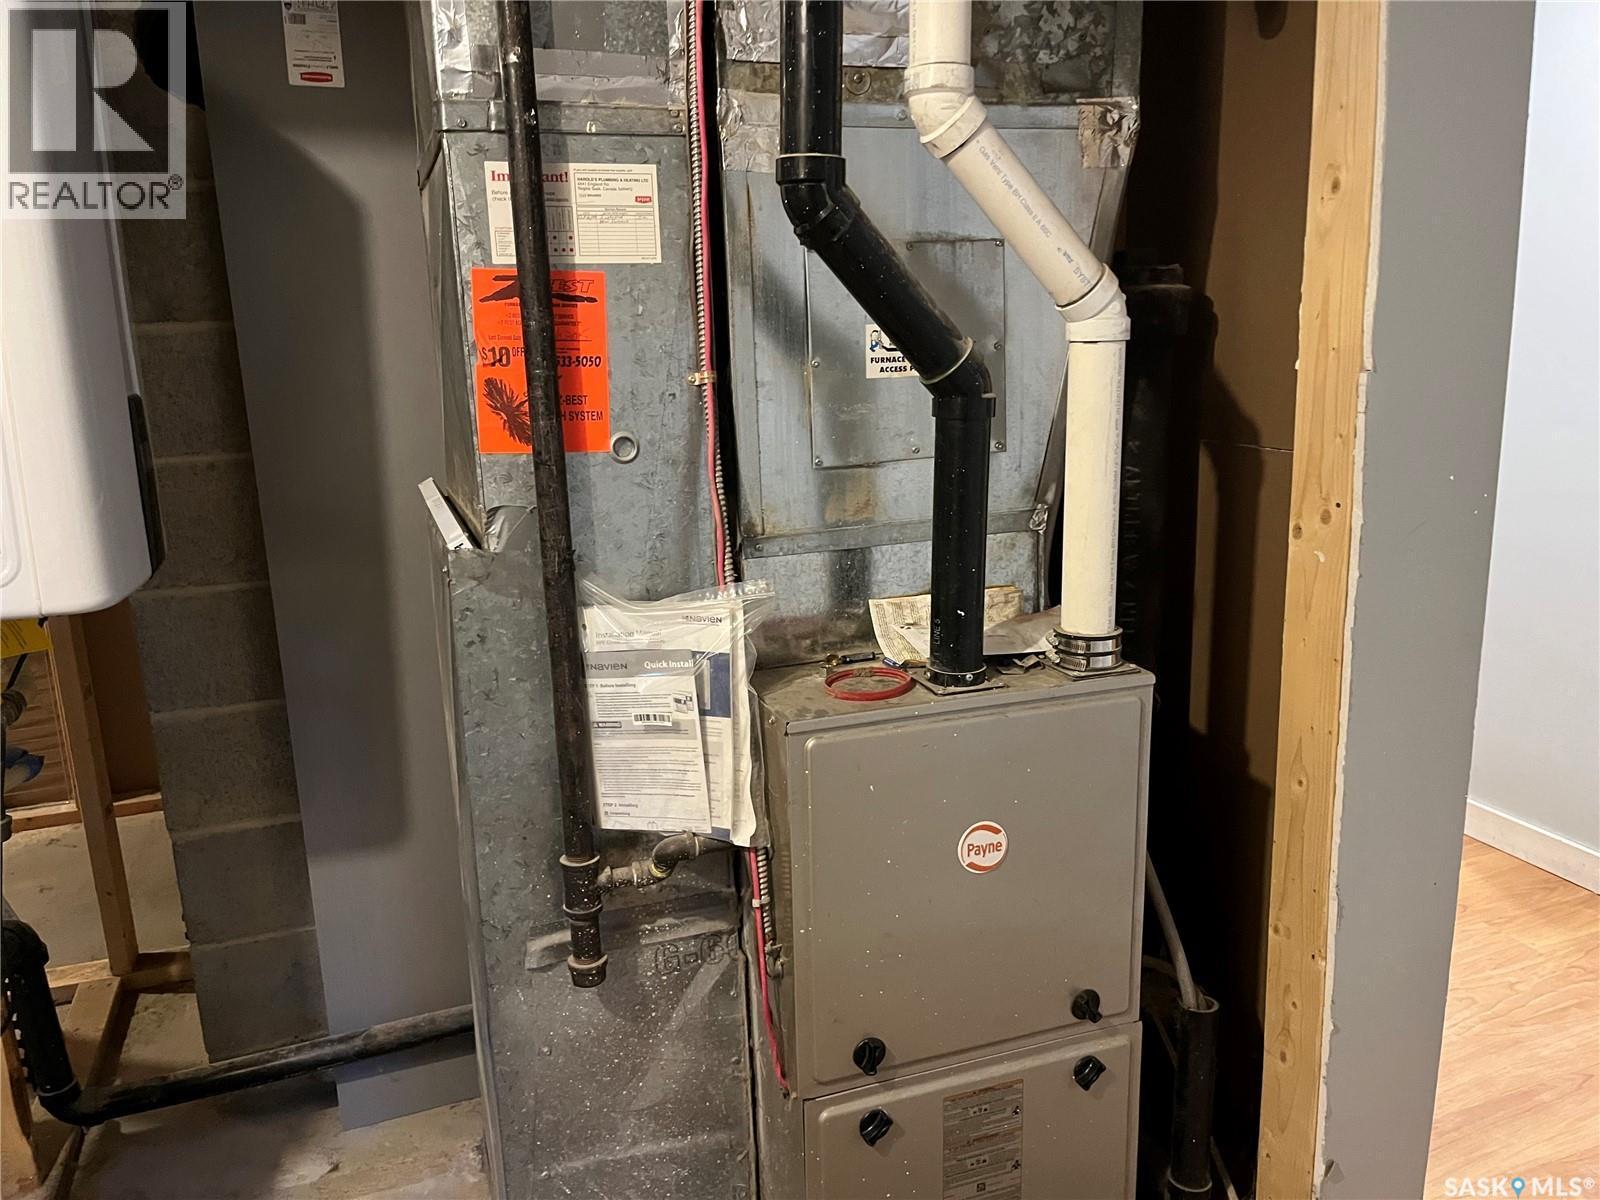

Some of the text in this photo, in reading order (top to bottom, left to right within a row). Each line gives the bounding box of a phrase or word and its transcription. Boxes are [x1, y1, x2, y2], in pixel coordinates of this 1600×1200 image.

[1000, 174, 1014, 190] Type
[569, 410, 603, 421] SYSTEM
[644, 660, 667, 669] Quick
[967, 841, 1002, 857] Payne
